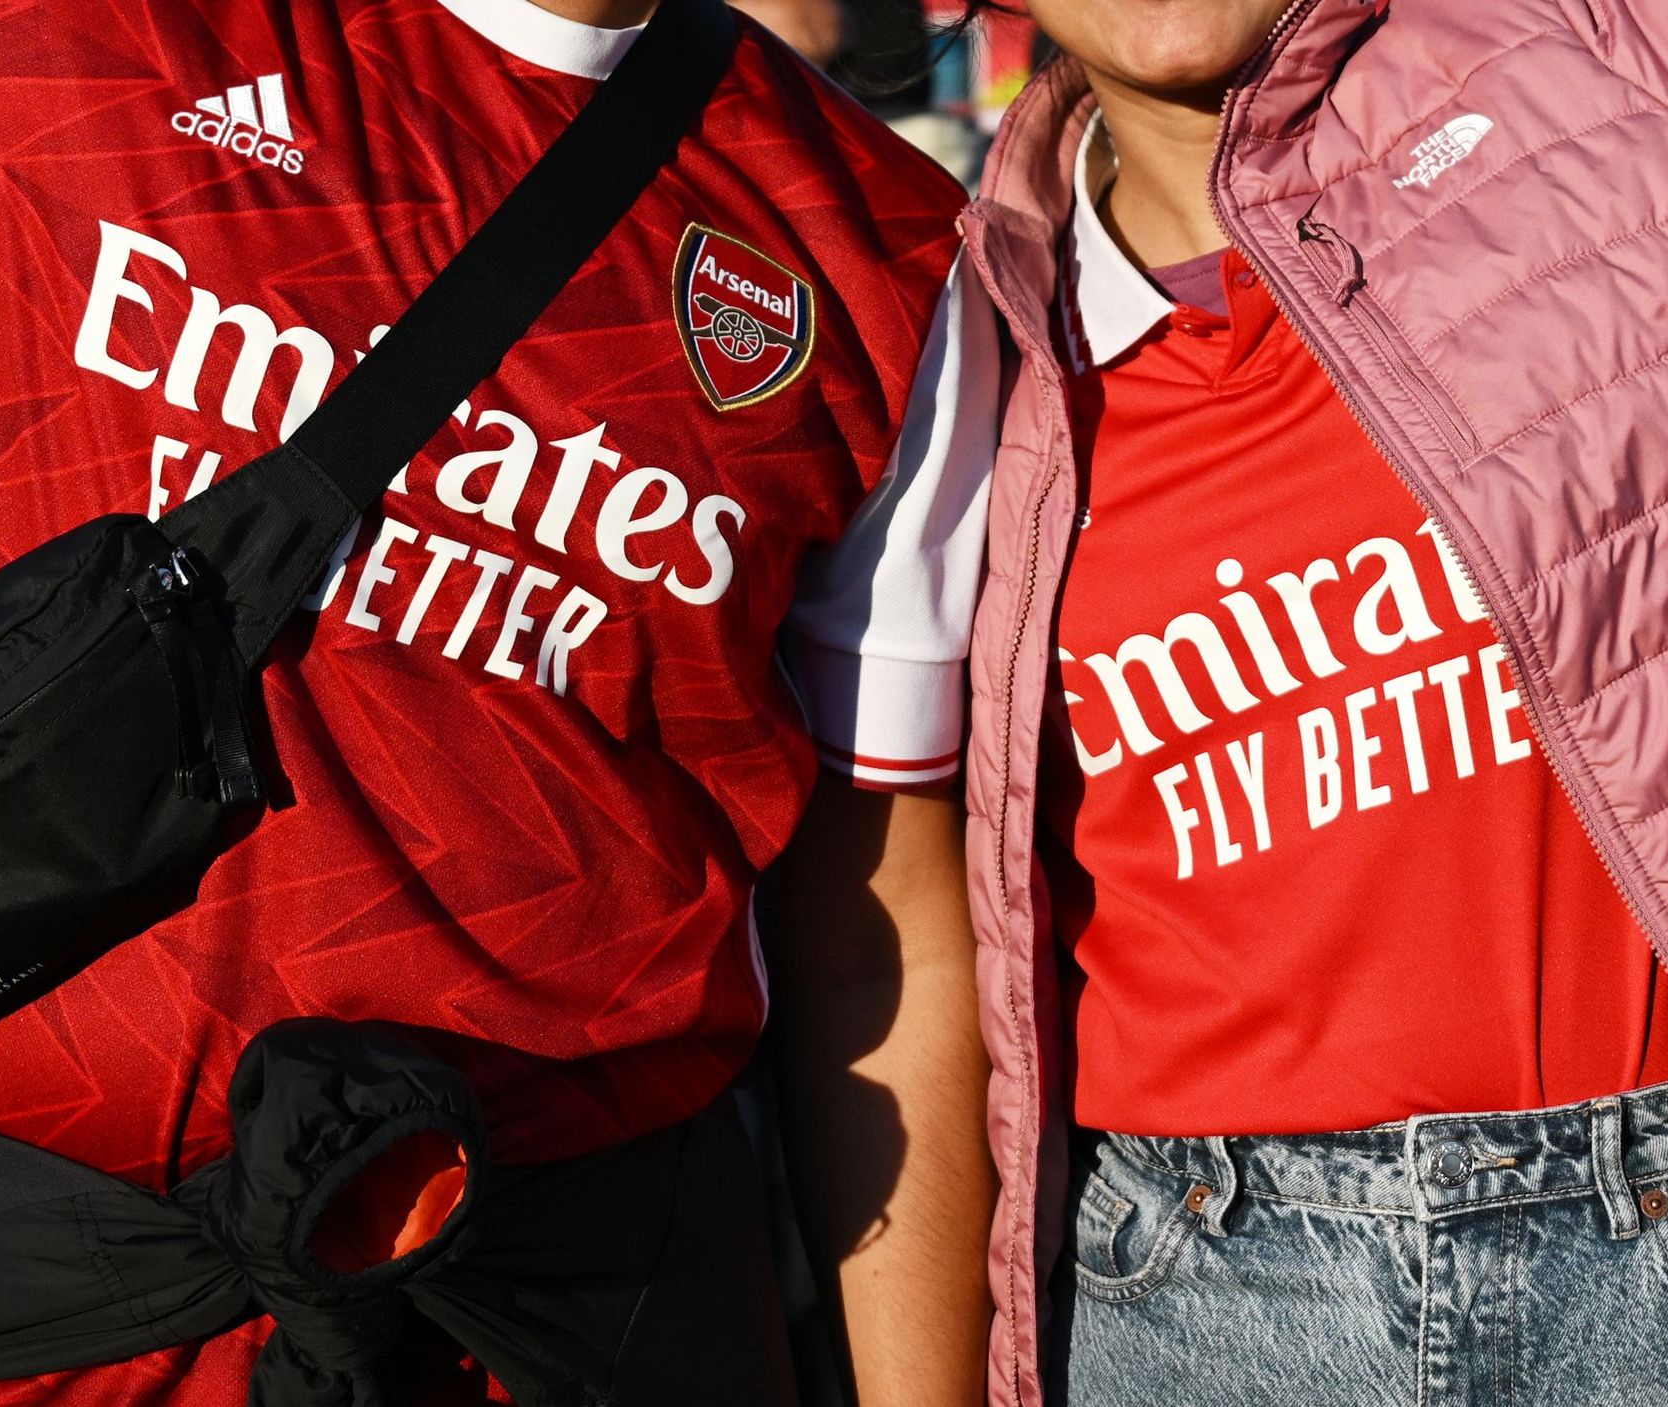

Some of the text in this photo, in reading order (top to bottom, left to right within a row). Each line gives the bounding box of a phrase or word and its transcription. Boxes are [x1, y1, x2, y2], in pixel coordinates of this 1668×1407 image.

[170, 108, 305, 175] adidas
[1392, 136, 1459, 189] NORTH
[1409, 129, 1447, 159] THE
[1420, 146, 1468, 188] FACE
[698, 254, 791, 319] Arsenal
[73, 219, 748, 606] Emates
[1152, 642, 1532, 880] FLY BETTE
